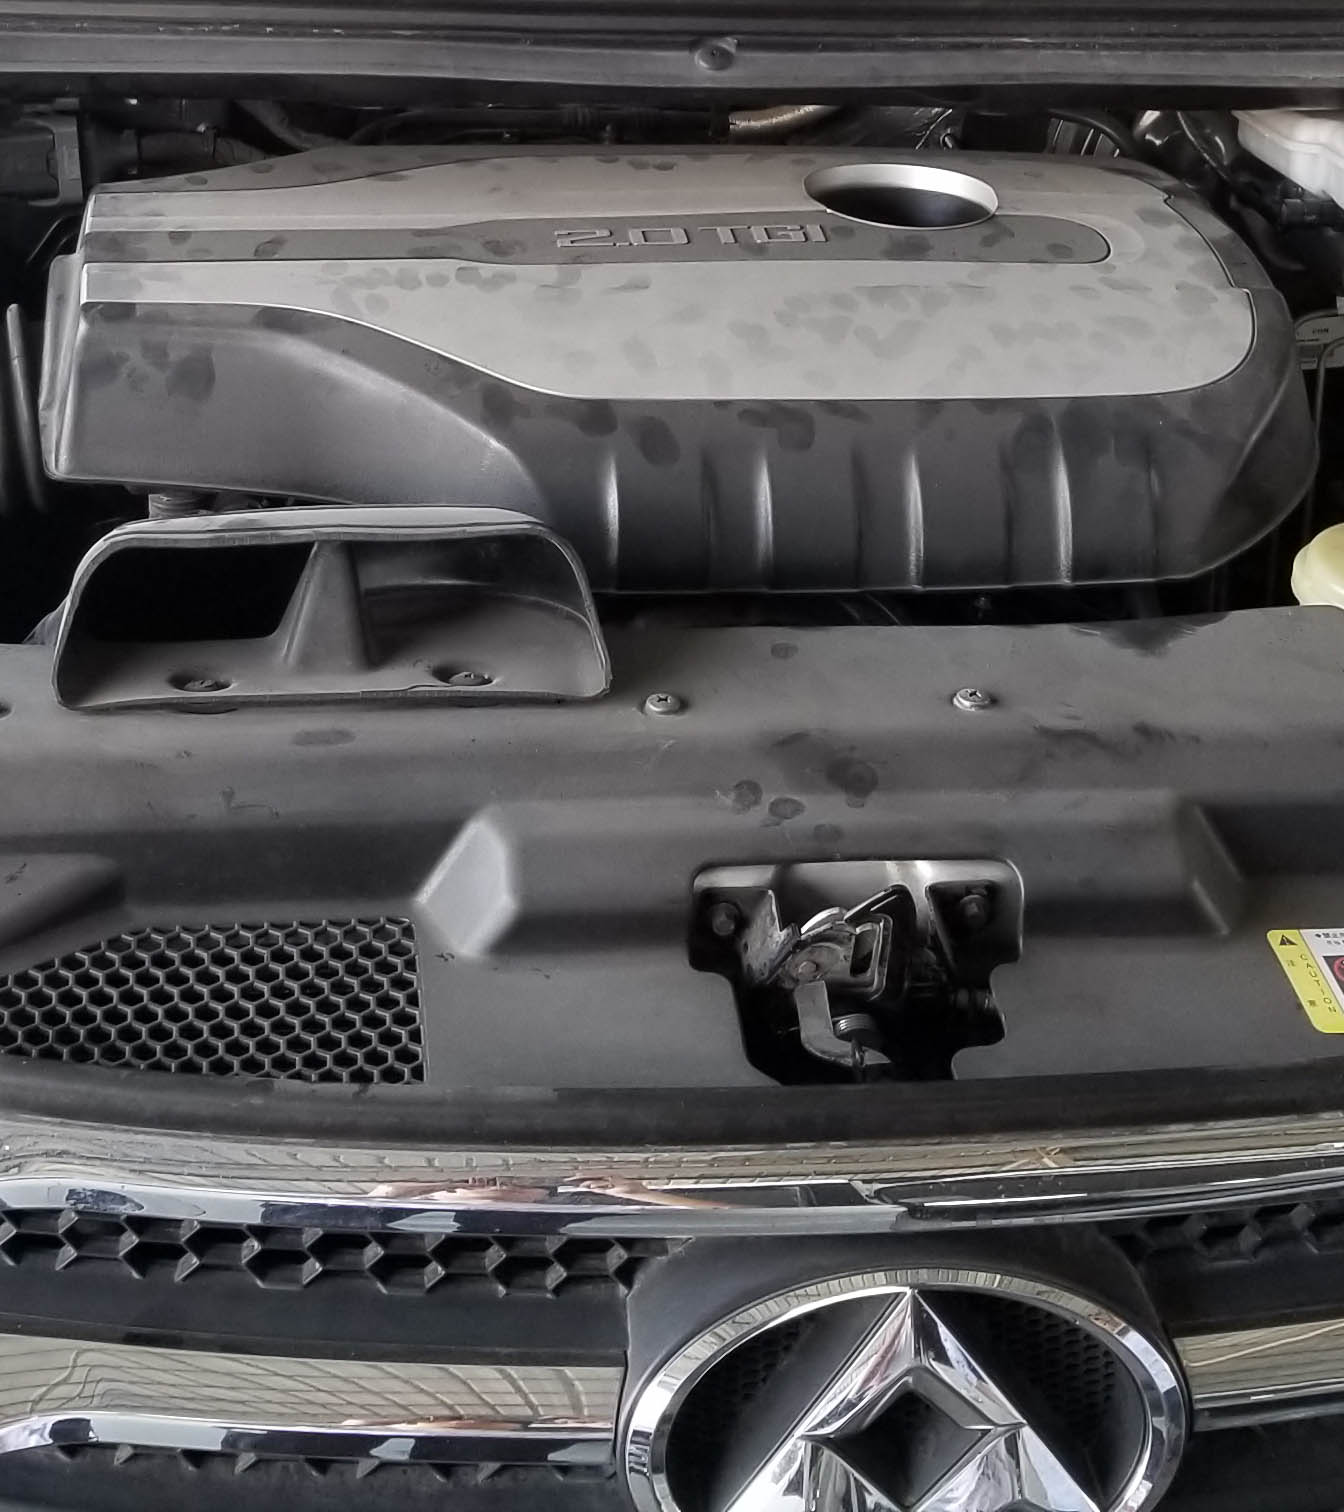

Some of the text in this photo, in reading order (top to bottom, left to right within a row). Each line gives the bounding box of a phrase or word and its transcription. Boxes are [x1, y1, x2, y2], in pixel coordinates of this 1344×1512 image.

[554, 224, 828, 248] 2.0 TGI
[1299, 953, 1337, 1013] CAUTION
